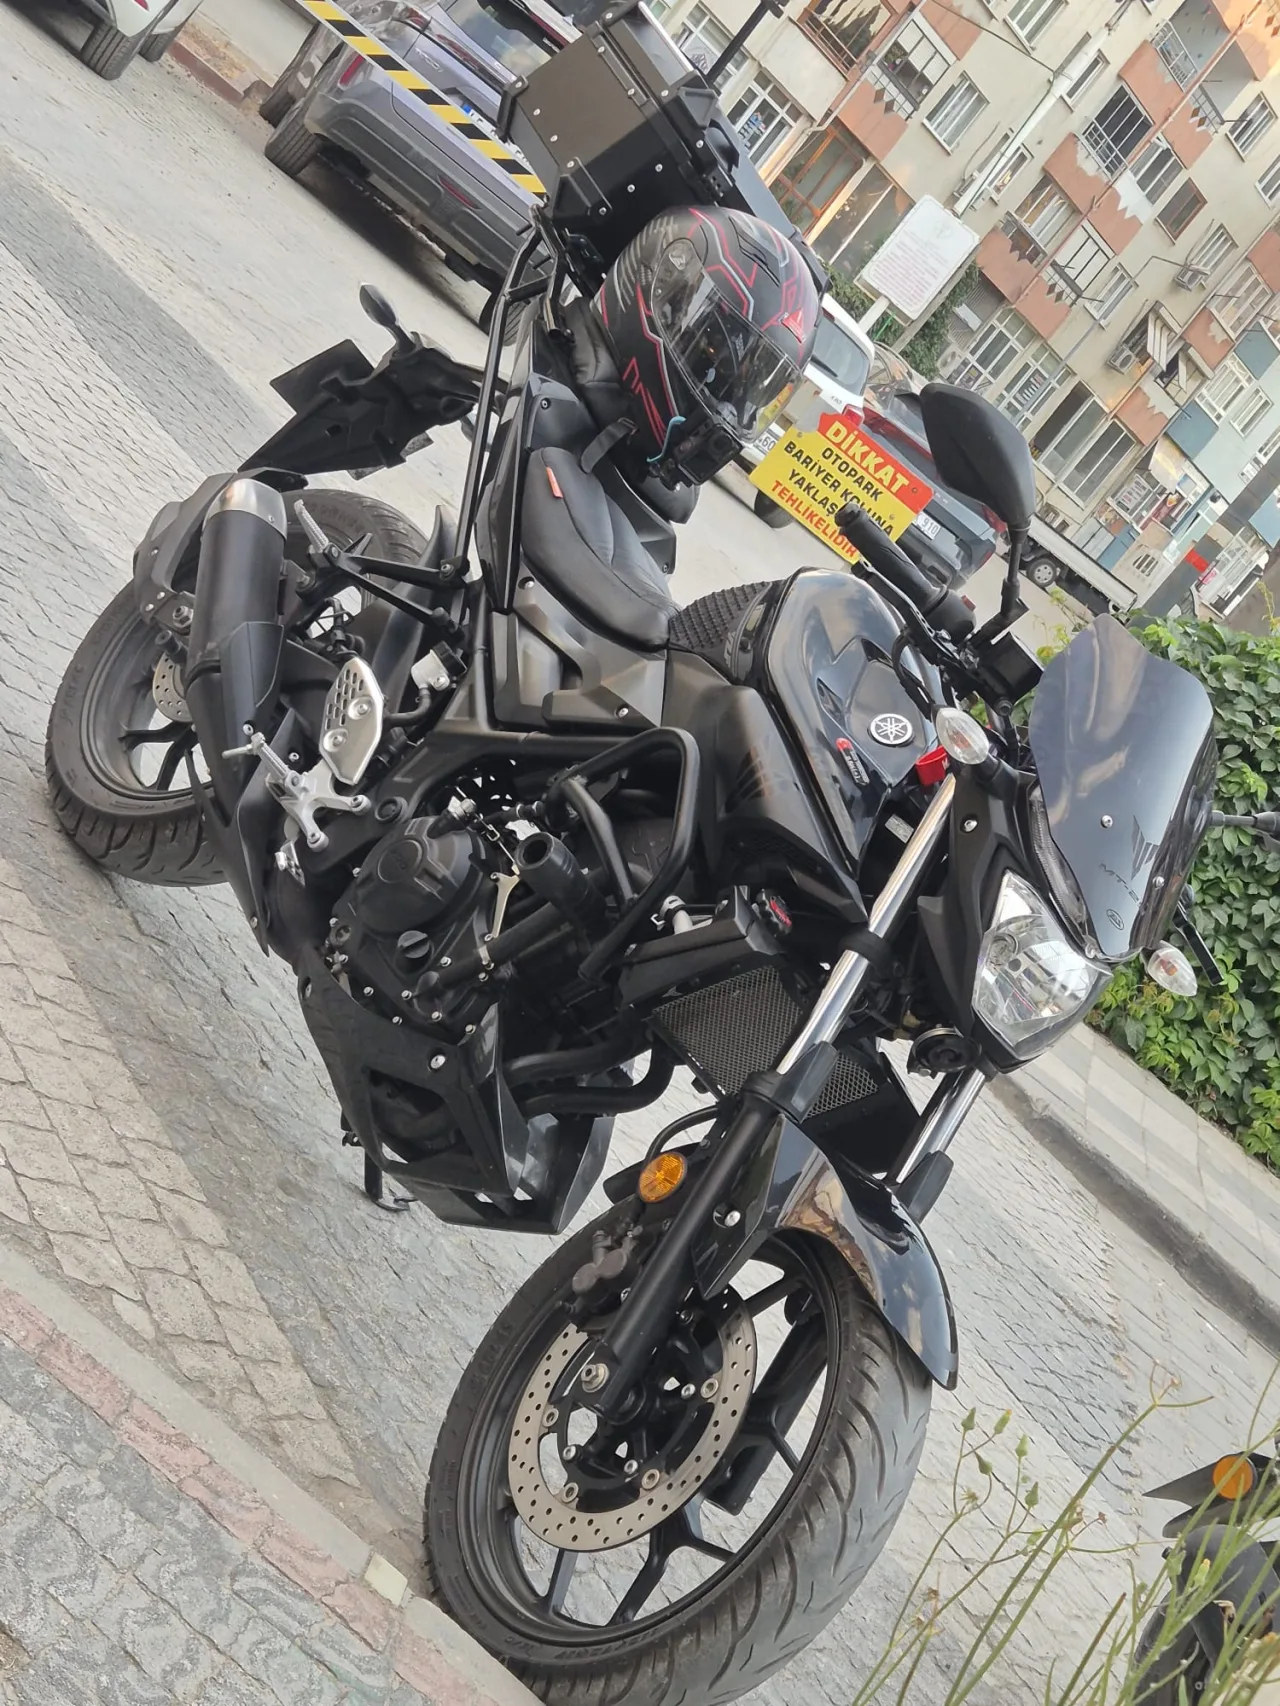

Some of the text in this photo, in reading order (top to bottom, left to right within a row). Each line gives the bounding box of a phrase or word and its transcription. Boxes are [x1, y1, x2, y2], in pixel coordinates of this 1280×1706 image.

[784, 440, 842, 491] BARİYER
[821, 447, 884, 502] OTOPARK
[825, 420, 910, 494] DİKKAT
[788, 469, 839, 517] YAKLAŞ
